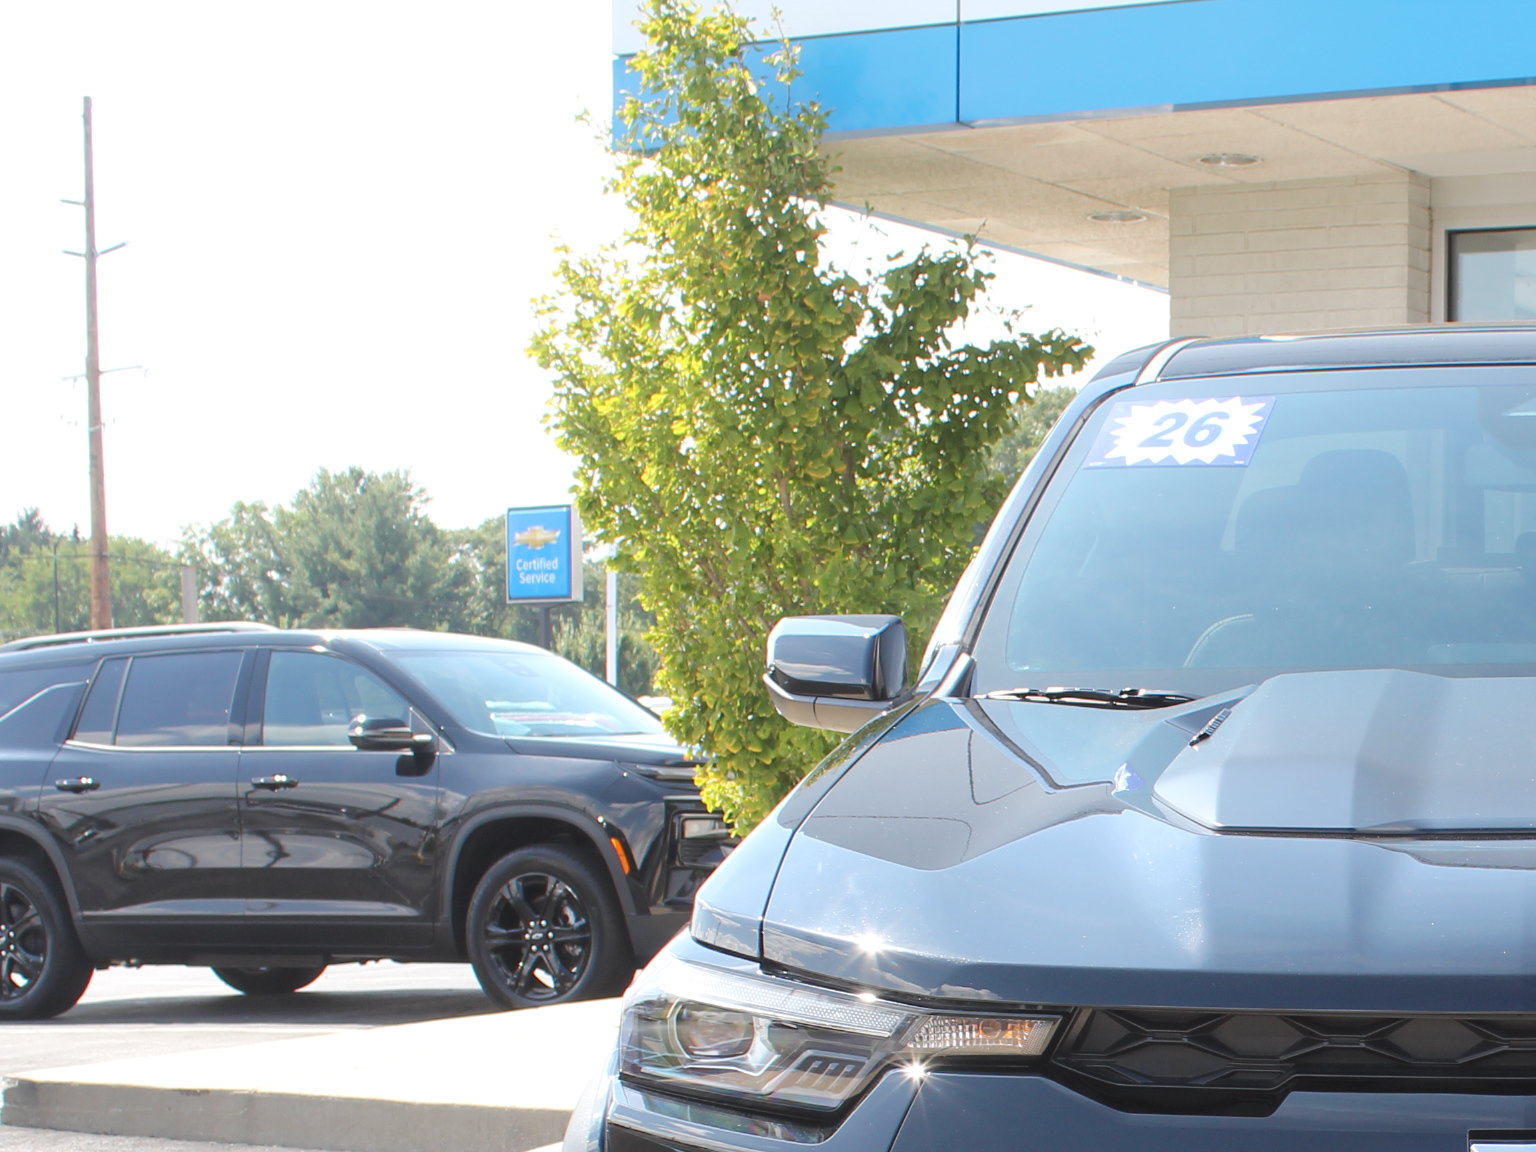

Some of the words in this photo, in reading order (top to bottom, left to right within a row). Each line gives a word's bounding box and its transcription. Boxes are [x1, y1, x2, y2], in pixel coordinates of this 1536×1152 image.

[1137, 411, 1230, 449] 26
[516, 557, 559, 571] Certified
[519, 572, 556, 584] Service
